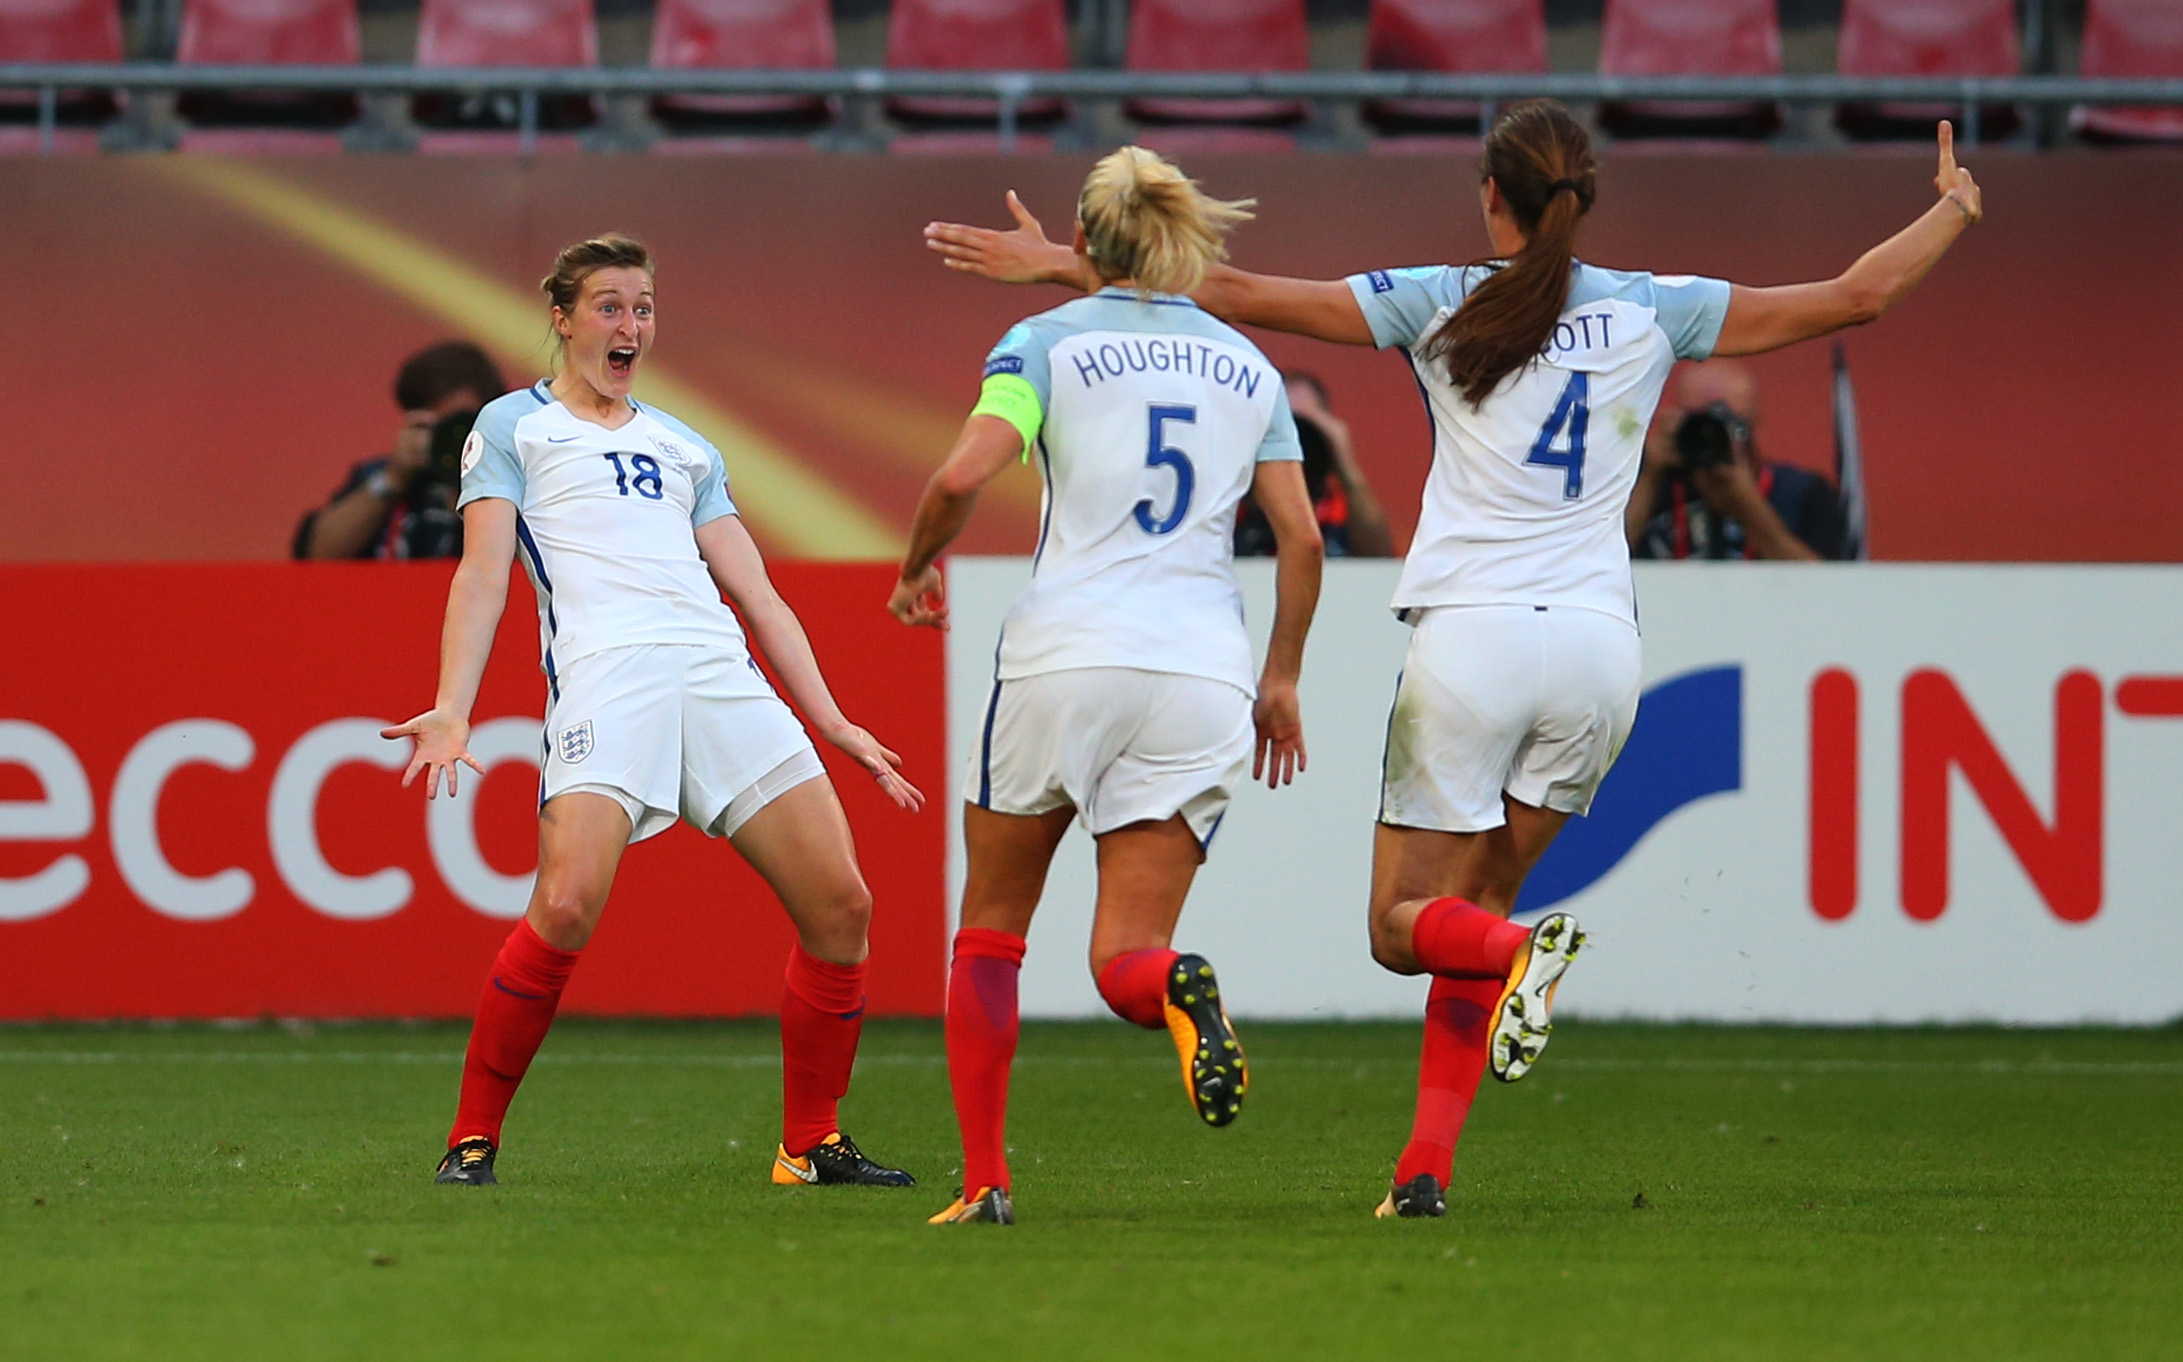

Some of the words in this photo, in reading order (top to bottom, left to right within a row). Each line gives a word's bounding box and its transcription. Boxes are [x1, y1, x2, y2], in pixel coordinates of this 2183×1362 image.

[1072, 339, 1261, 398] HOUGHTON
[1541, 313, 1613, 353] OTT
[603, 452, 663, 500] 18
[1133, 401, 1196, 536] 5
[1521, 370, 1590, 502] 4
[0, 717, 540, 921] ecco
